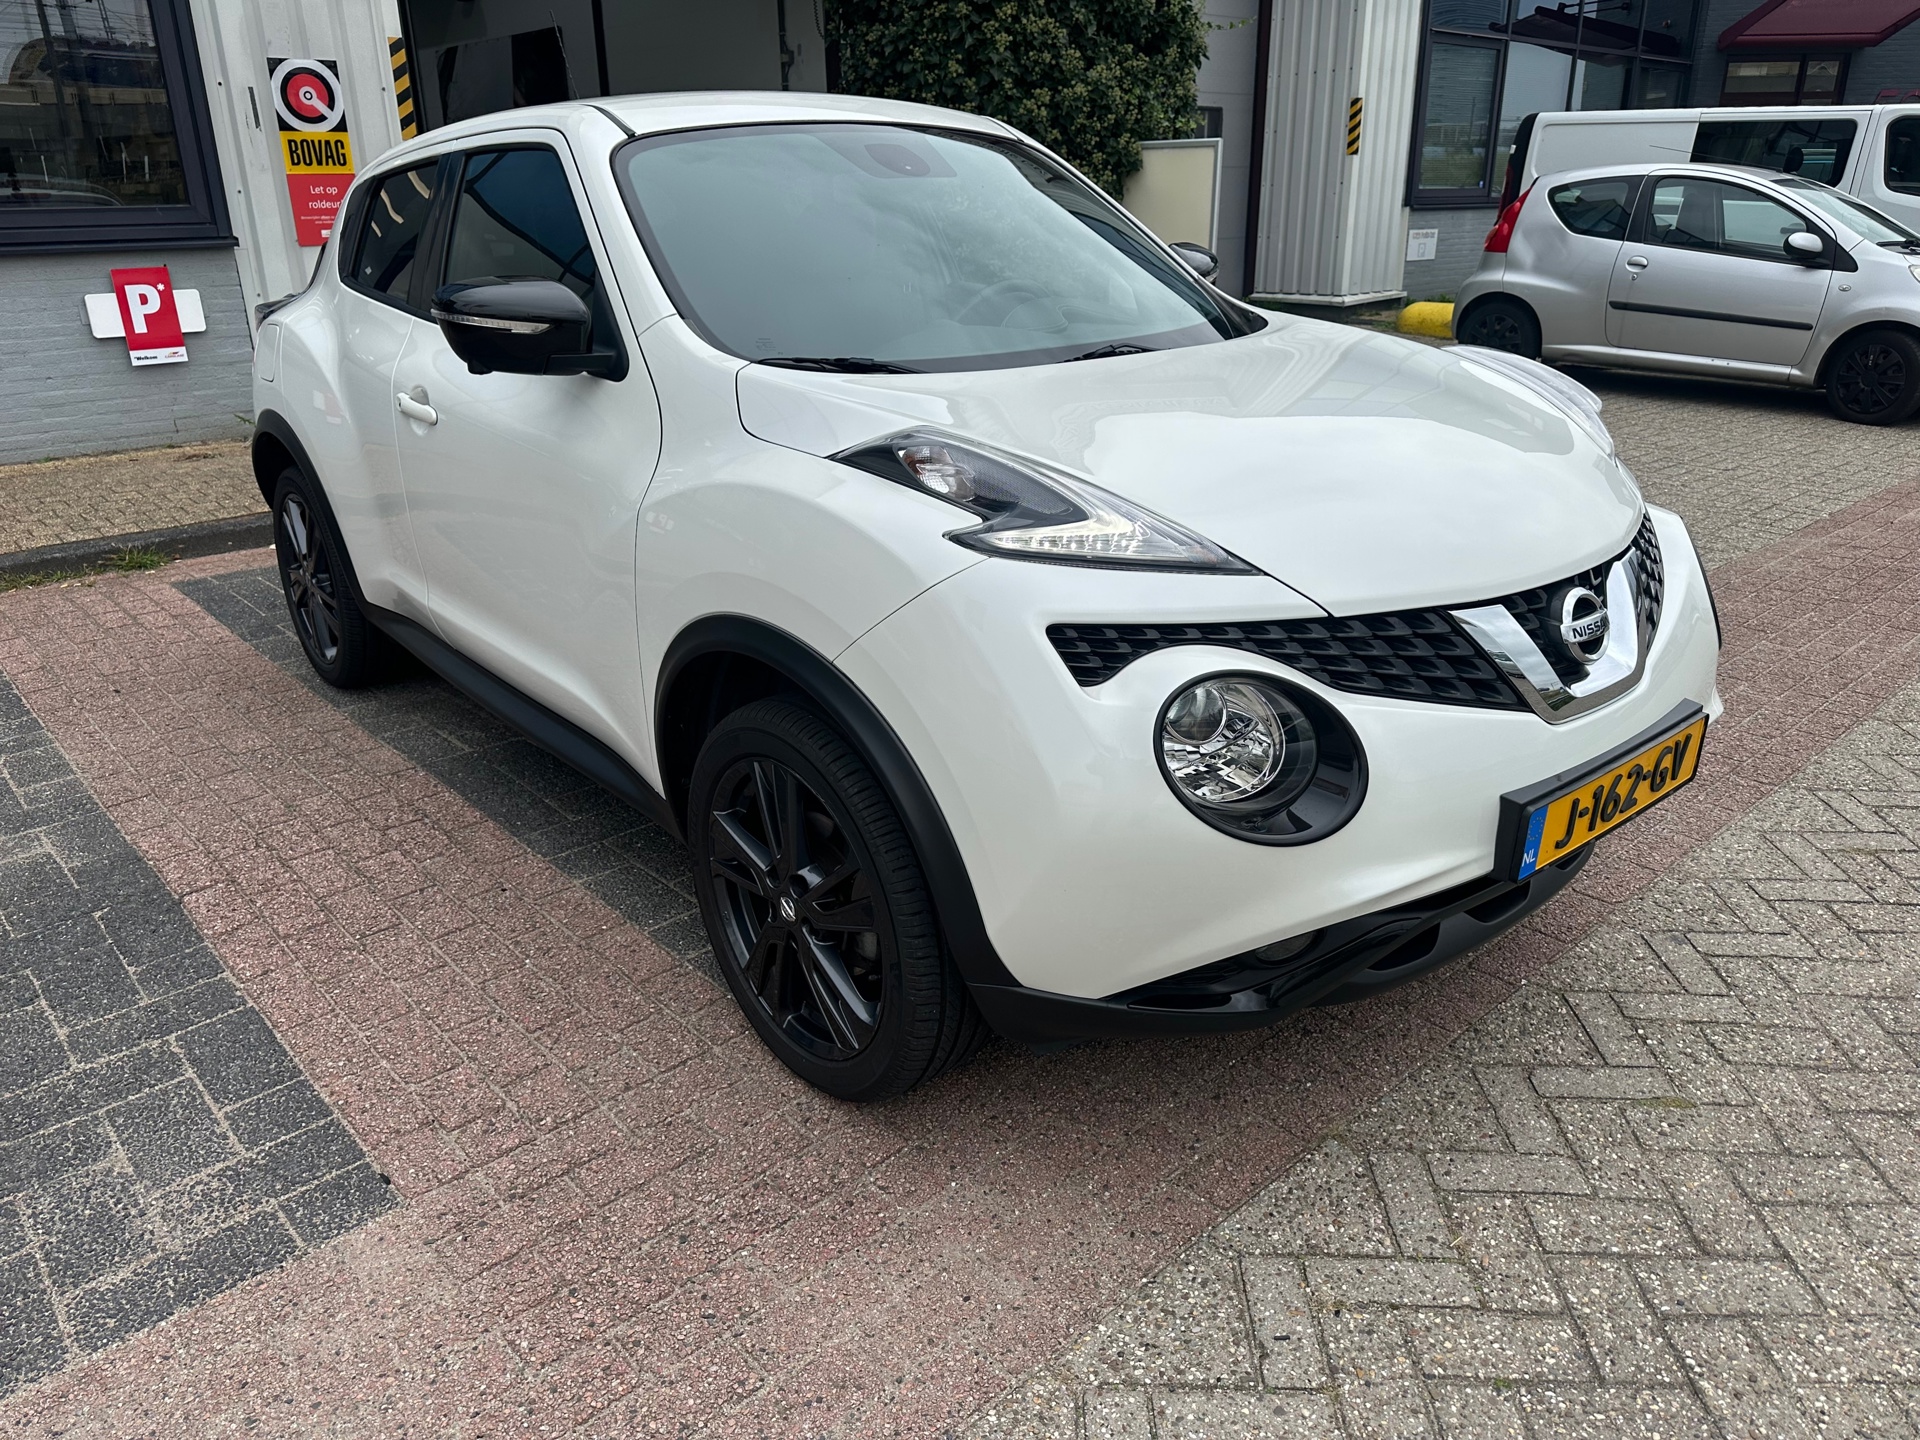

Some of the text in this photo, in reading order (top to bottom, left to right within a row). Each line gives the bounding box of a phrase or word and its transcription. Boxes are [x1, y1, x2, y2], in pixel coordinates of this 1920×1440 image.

[287, 139, 347, 166] BOVAG
[310, 185, 338, 195] Let op
[1572, 619, 1606, 639] NISSA
[1554, 733, 1692, 850] J-162-GV
[1521, 848, 1535, 867] NL
